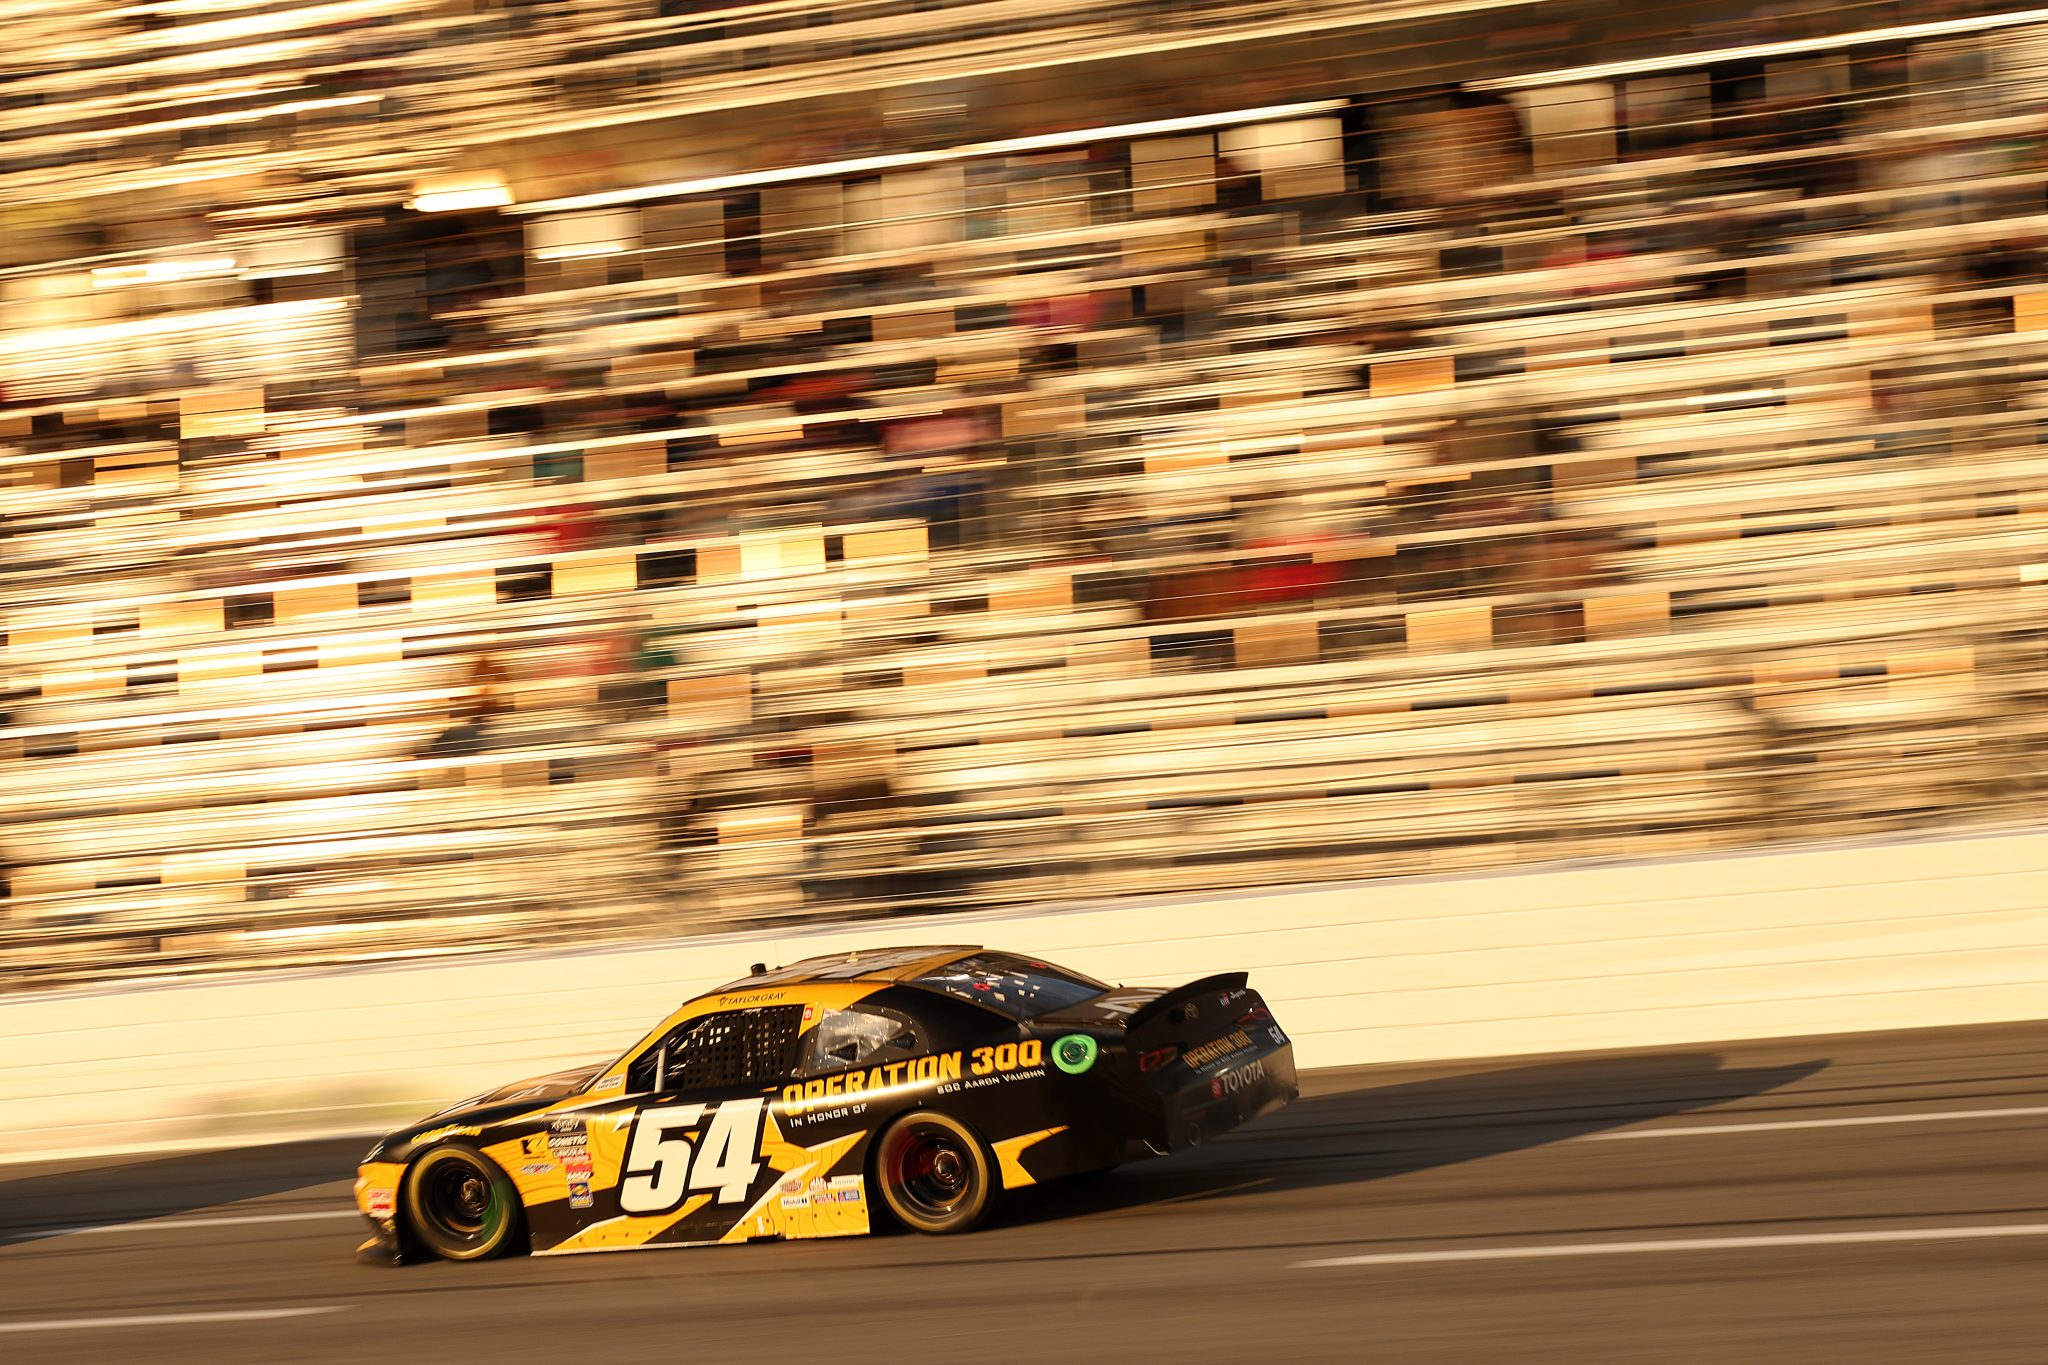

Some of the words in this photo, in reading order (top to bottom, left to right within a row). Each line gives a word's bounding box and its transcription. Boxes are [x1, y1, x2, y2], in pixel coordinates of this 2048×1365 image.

[1182, 1036, 1237, 1069] OPERATION
[1229, 1030, 1254, 1049] 300
[1267, 1025, 1286, 1045] 54
[783, 1051, 962, 1117] OPERATION
[971, 1039, 1043, 1075] 300
[965, 1077, 1000, 1090] AARON
[1002, 1069, 1046, 1083] VAUGHN
[1221, 1060, 1265, 1095] TOYOTA
[790, 1118, 803, 1128] IN
[807, 1107, 849, 1125] HONOR
[852, 1103, 867, 1114] OF
[548, 1135, 587, 1148] COMETIC
[620, 1097, 765, 1212] 54
